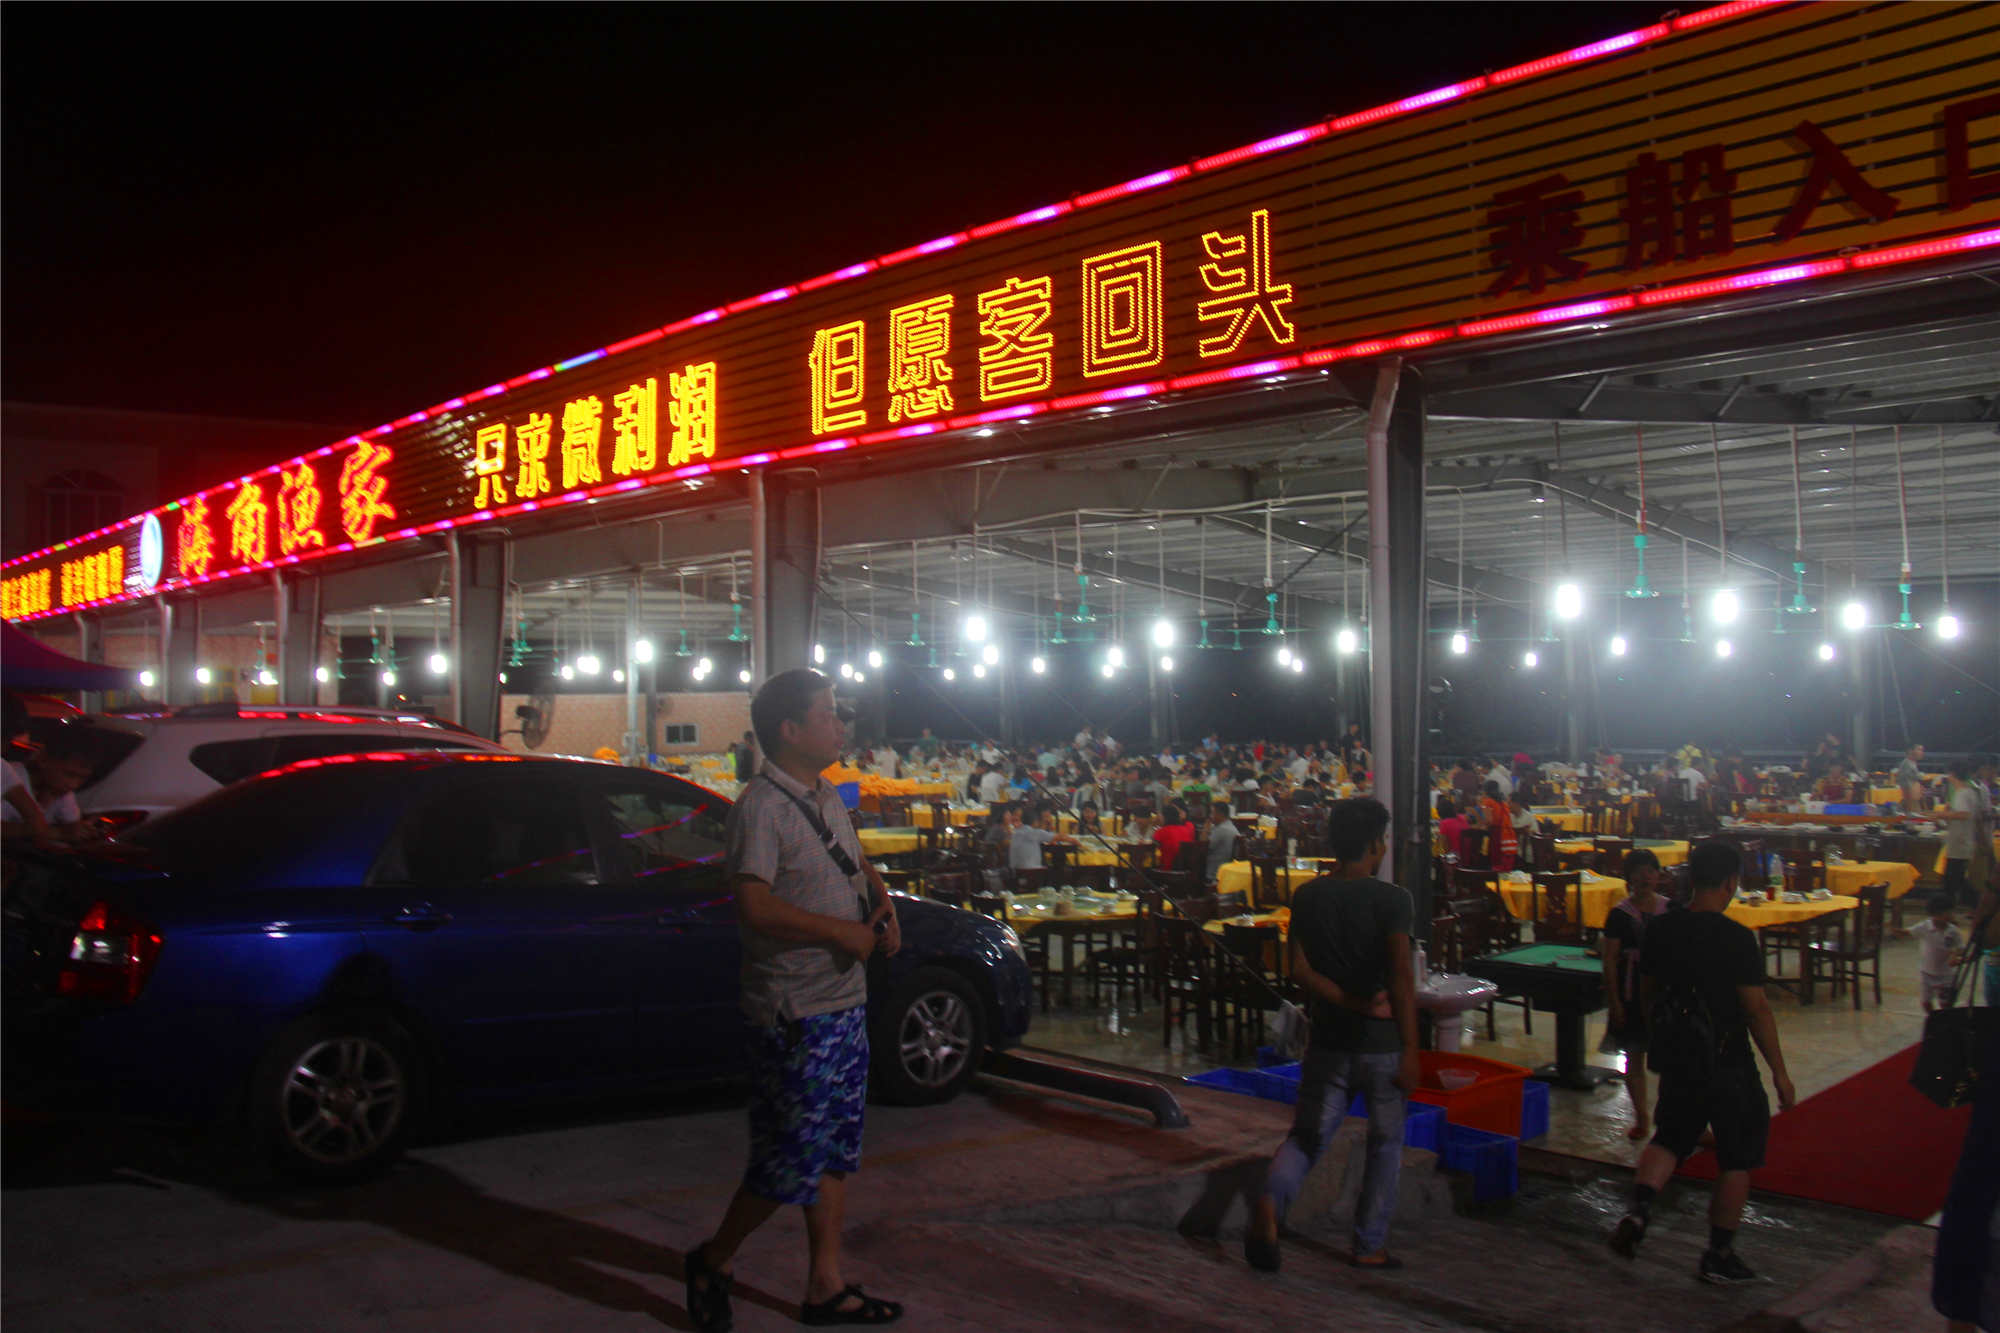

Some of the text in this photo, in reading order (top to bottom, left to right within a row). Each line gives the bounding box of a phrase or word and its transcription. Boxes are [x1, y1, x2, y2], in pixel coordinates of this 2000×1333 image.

[473, 208, 1297, 510] 只求微利润 但愿客回头
